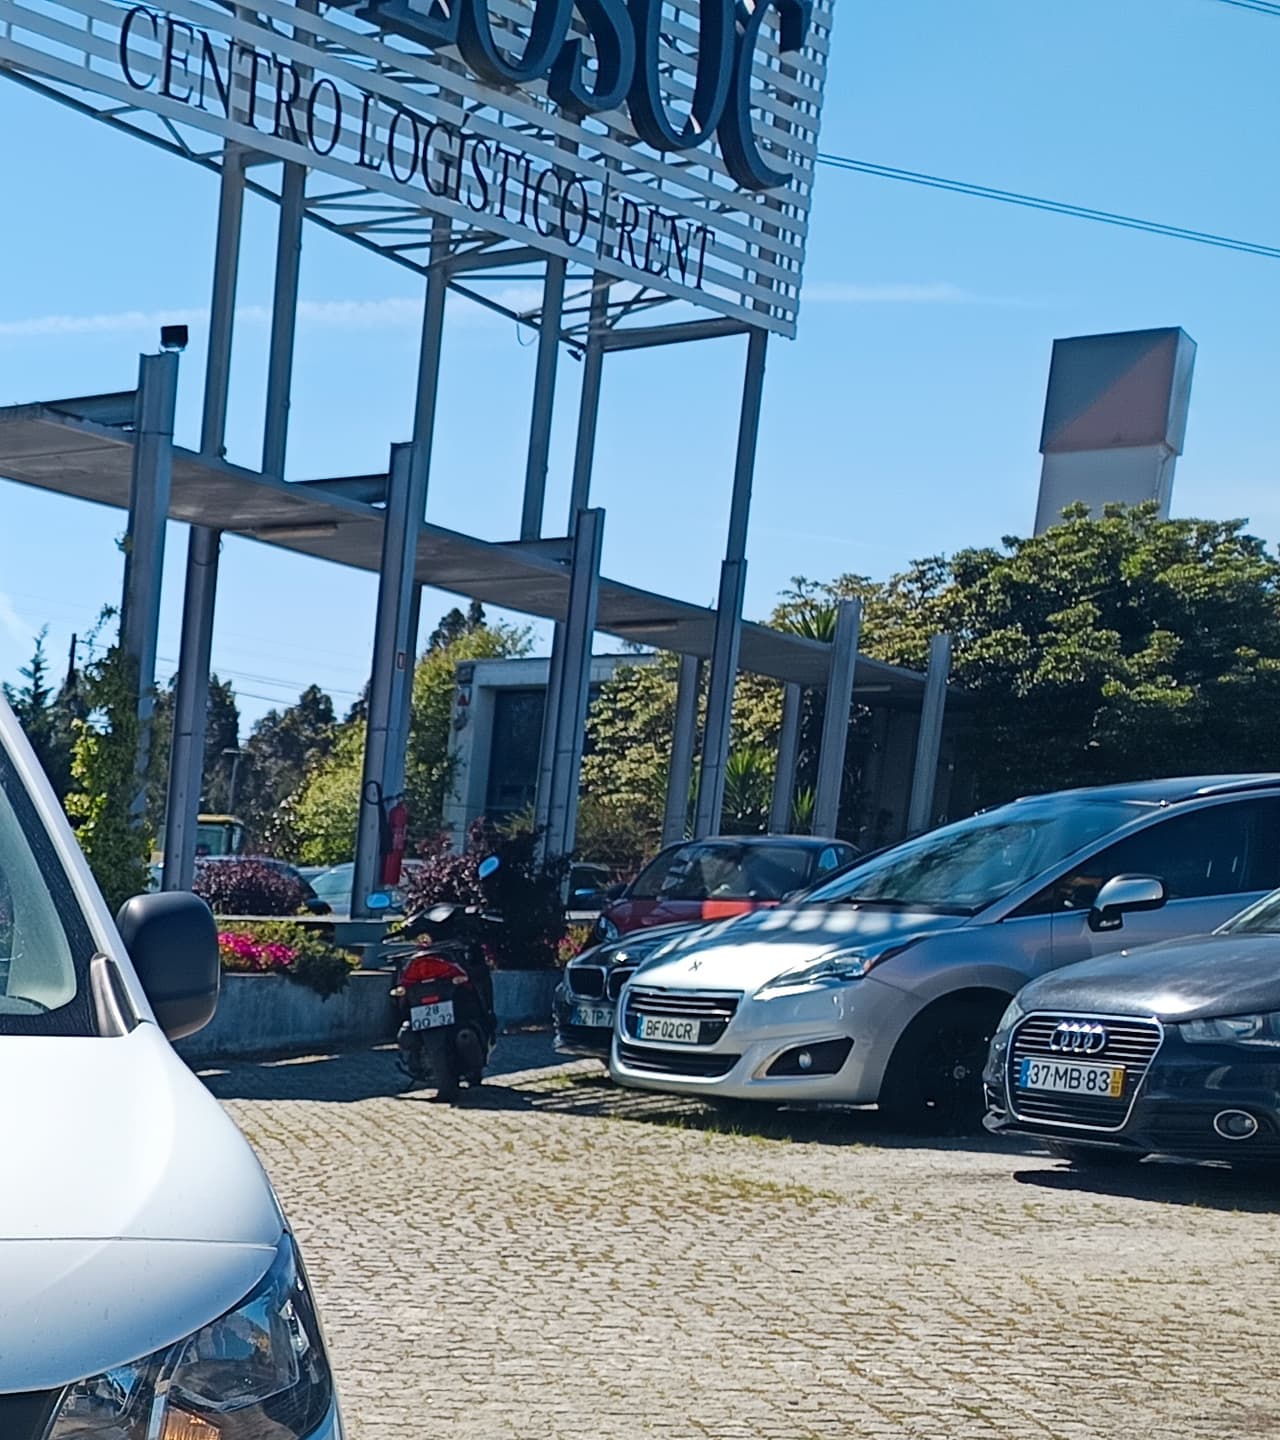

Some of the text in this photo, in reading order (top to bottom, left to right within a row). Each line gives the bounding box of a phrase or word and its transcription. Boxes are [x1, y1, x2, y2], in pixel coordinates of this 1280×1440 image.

[119, 5, 342, 156] CENTRO
[354, 92, 589, 247] LOGÍSTICO
[616, 197, 715, 289] RENT
